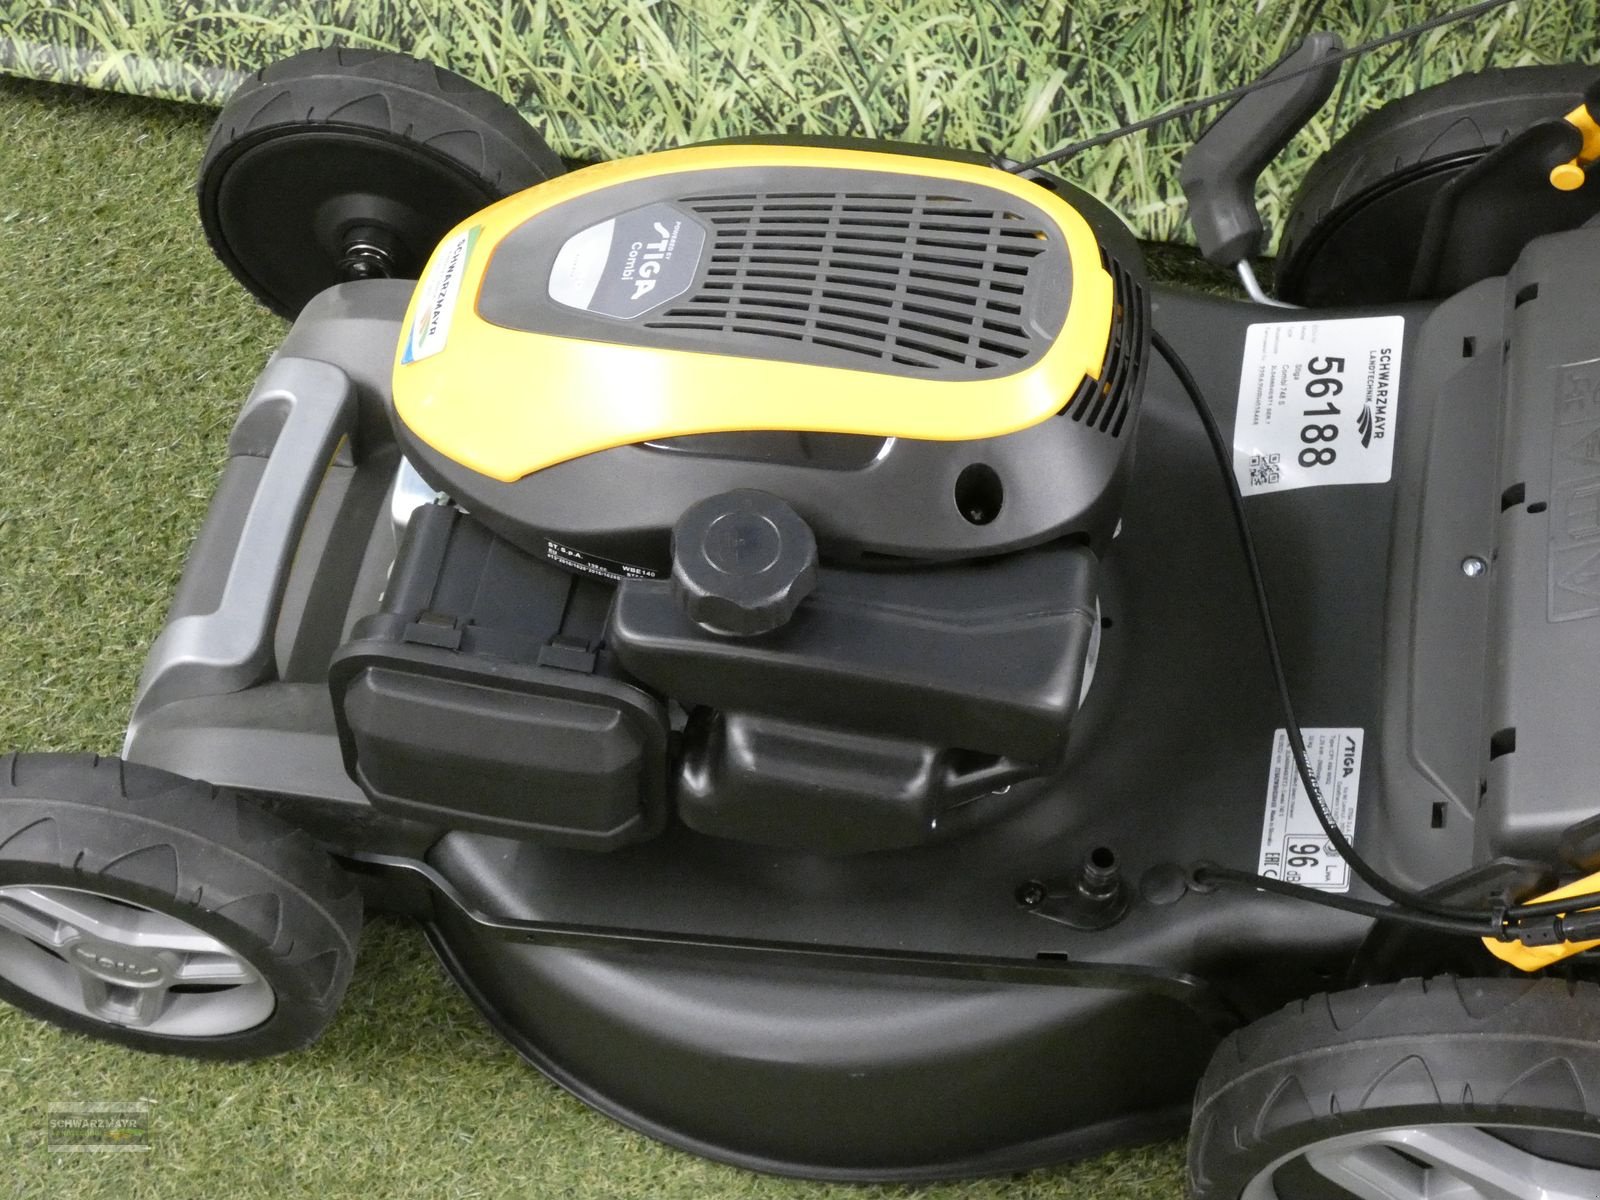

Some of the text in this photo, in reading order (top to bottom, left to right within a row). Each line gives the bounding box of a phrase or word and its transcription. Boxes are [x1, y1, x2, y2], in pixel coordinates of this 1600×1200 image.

[621, 241, 643, 281] Combi
[630, 221, 670, 300] STIGA
[428, 237, 466, 336] SCHWARZMAYR
[1280, 364, 1290, 387] Combi
[1365, 350, 1377, 403] LANDTECHNIK
[1373, 347, 1392, 439] SCHWARZMAYR
[1298, 355, 1346, 468] 56188
[1342, 736, 1356, 778] STIGA
[1286, 870, 1302, 882] dB
[1287, 843, 1321, 868] 96
